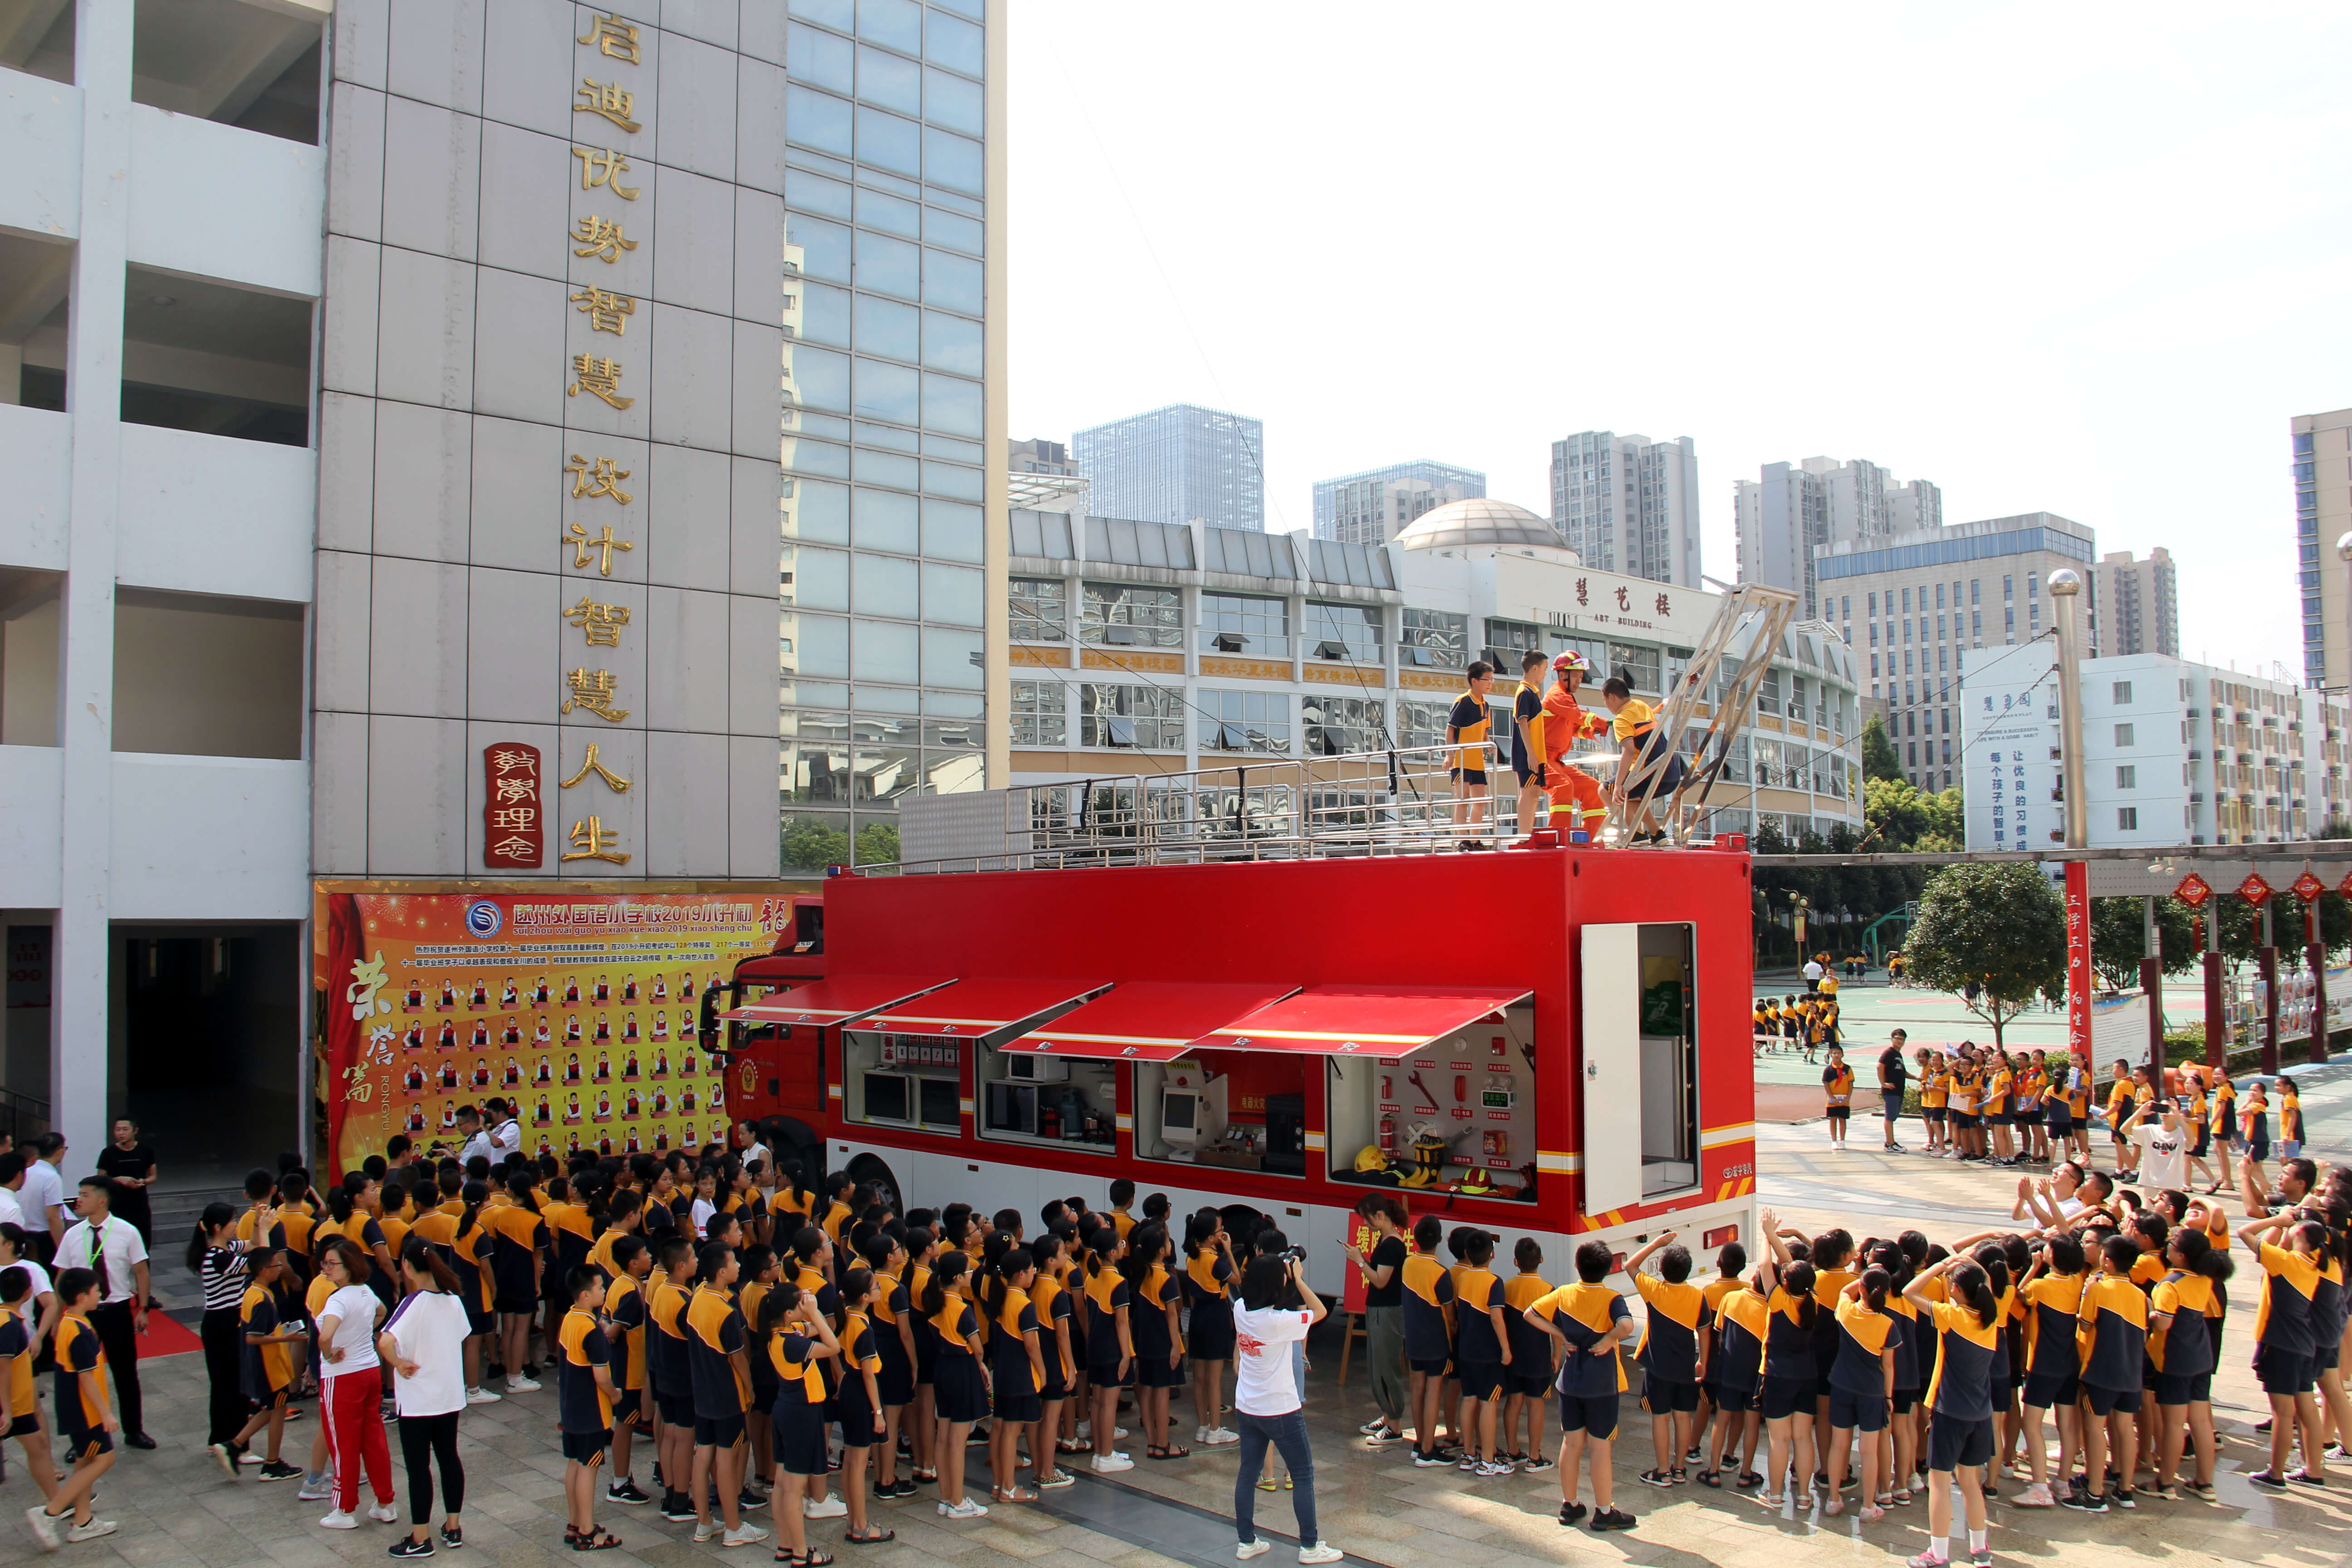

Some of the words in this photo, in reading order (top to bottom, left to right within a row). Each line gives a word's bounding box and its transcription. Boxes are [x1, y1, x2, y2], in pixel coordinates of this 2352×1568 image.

[1575, 577, 1671, 617] 慧艺楼
[1594, 614, 1609, 623] ART
[1618, 617, 1652, 630] BUILDING
[559, 454, 634, 866] 设计智慧人生
[514, 926, 527, 935] sui
[530, 926, 552, 935] zhou
[556, 926, 572, 934] wai
[575, 927, 591, 936] guo
[595, 927, 605, 936] yu
[608, 926, 626, 934] xiao
[647, 924, 665, 933] xiao
[668, 924, 687, 932] 2019
[690, 923, 707, 932] xiao
[710, 923, 735, 933] sheng
[380, 1075, 390, 1131] RONGYU
[1242, 1096, 1265, 1109] 电器火灾
